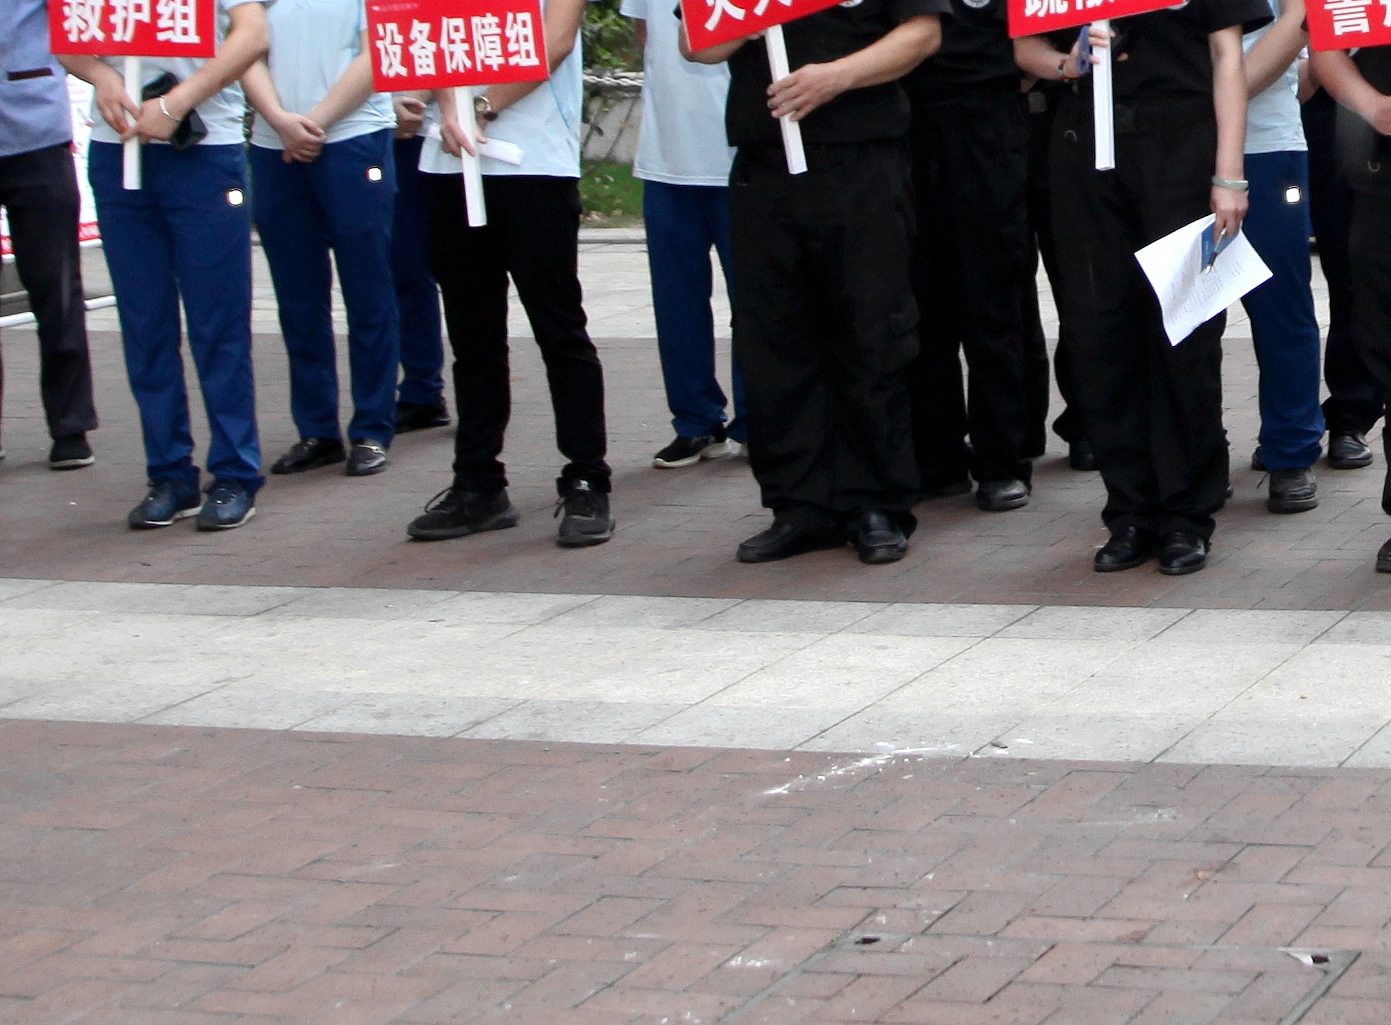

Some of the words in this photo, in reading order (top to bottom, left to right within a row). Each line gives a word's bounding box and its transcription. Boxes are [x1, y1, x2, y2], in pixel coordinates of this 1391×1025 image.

[376, 11, 540, 77] 设备保障组
